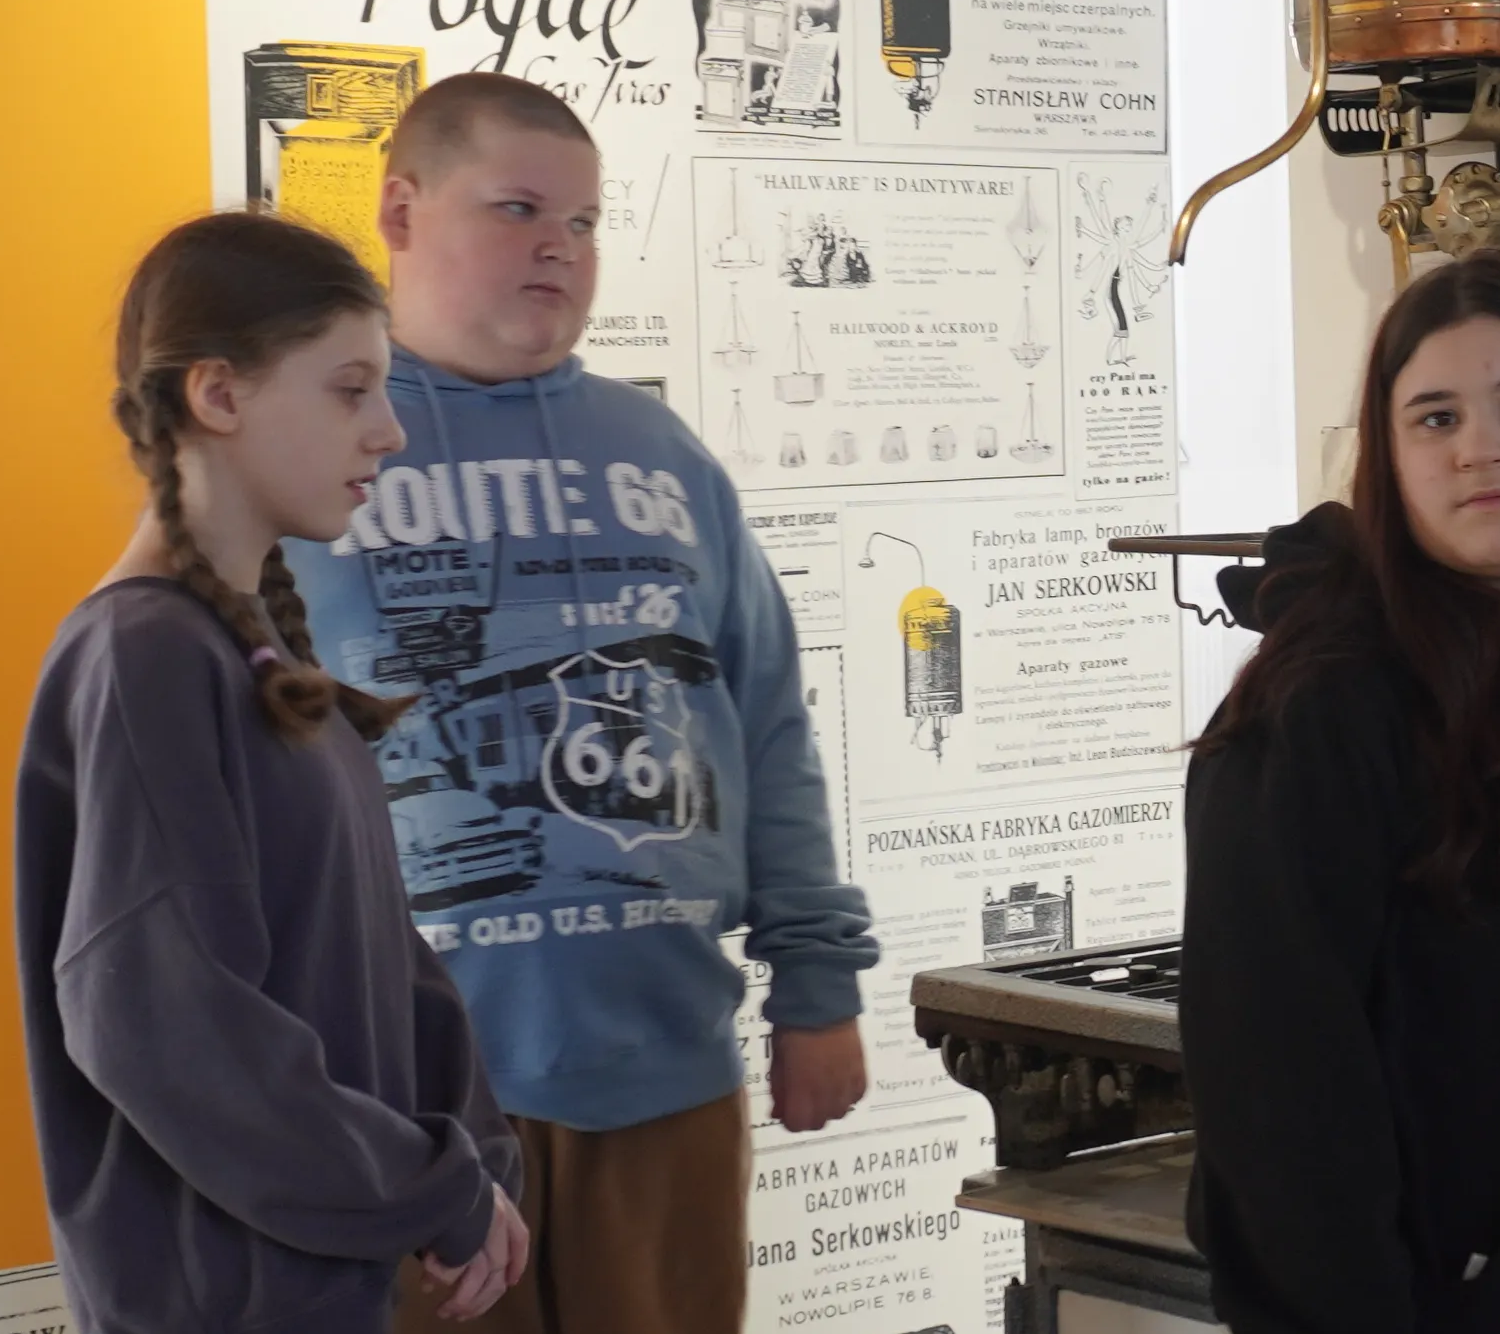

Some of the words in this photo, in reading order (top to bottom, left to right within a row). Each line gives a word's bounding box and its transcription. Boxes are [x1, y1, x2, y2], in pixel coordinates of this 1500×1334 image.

[1027, 0, 1069, 14] miejsc
[1072, 2, 1156, 19] czerpalnych.
[590, 56, 671, 123] Fires
[973, 88, 1088, 109] STANISŁAW
[1099, 93, 1156, 111] COHN
[895, 177, 1015, 196] DAINTYWARE!
[587, 335, 670, 347] MANCHESTER
[829, 322, 910, 335] HAILWOOD
[930, 322, 999, 334] ACKROYD
[1110, 371, 1135, 382] Pani
[605, 462, 698, 548] 66
[972, 528, 1036, 550] Fabryka
[1045, 527, 1088, 543] lamp,
[988, 550, 1069, 574] aparatów
[984, 582, 1025, 608] JAN
[1034, 571, 1158, 600] SERKOWSKI
[1016, 661, 1071, 677] Aparaty
[1080, 657, 1129, 672] gazowe
[867, 820, 975, 854] POZNAŃSKA
[982, 814, 1062, 841] FABRYKA
[1068, 800, 1174, 831] GAZOMIERZY
[468, 911, 544, 947] OLD
[755, 1159, 839, 1193] ABRYKA
[853, 1139, 959, 1176] APARATÓW
[805, 1178, 906, 1213] GAZOWYCH
[812, 1210, 961, 1257] Serkowskiego
[779, 1295, 885, 1328] NOWOLIPIE
